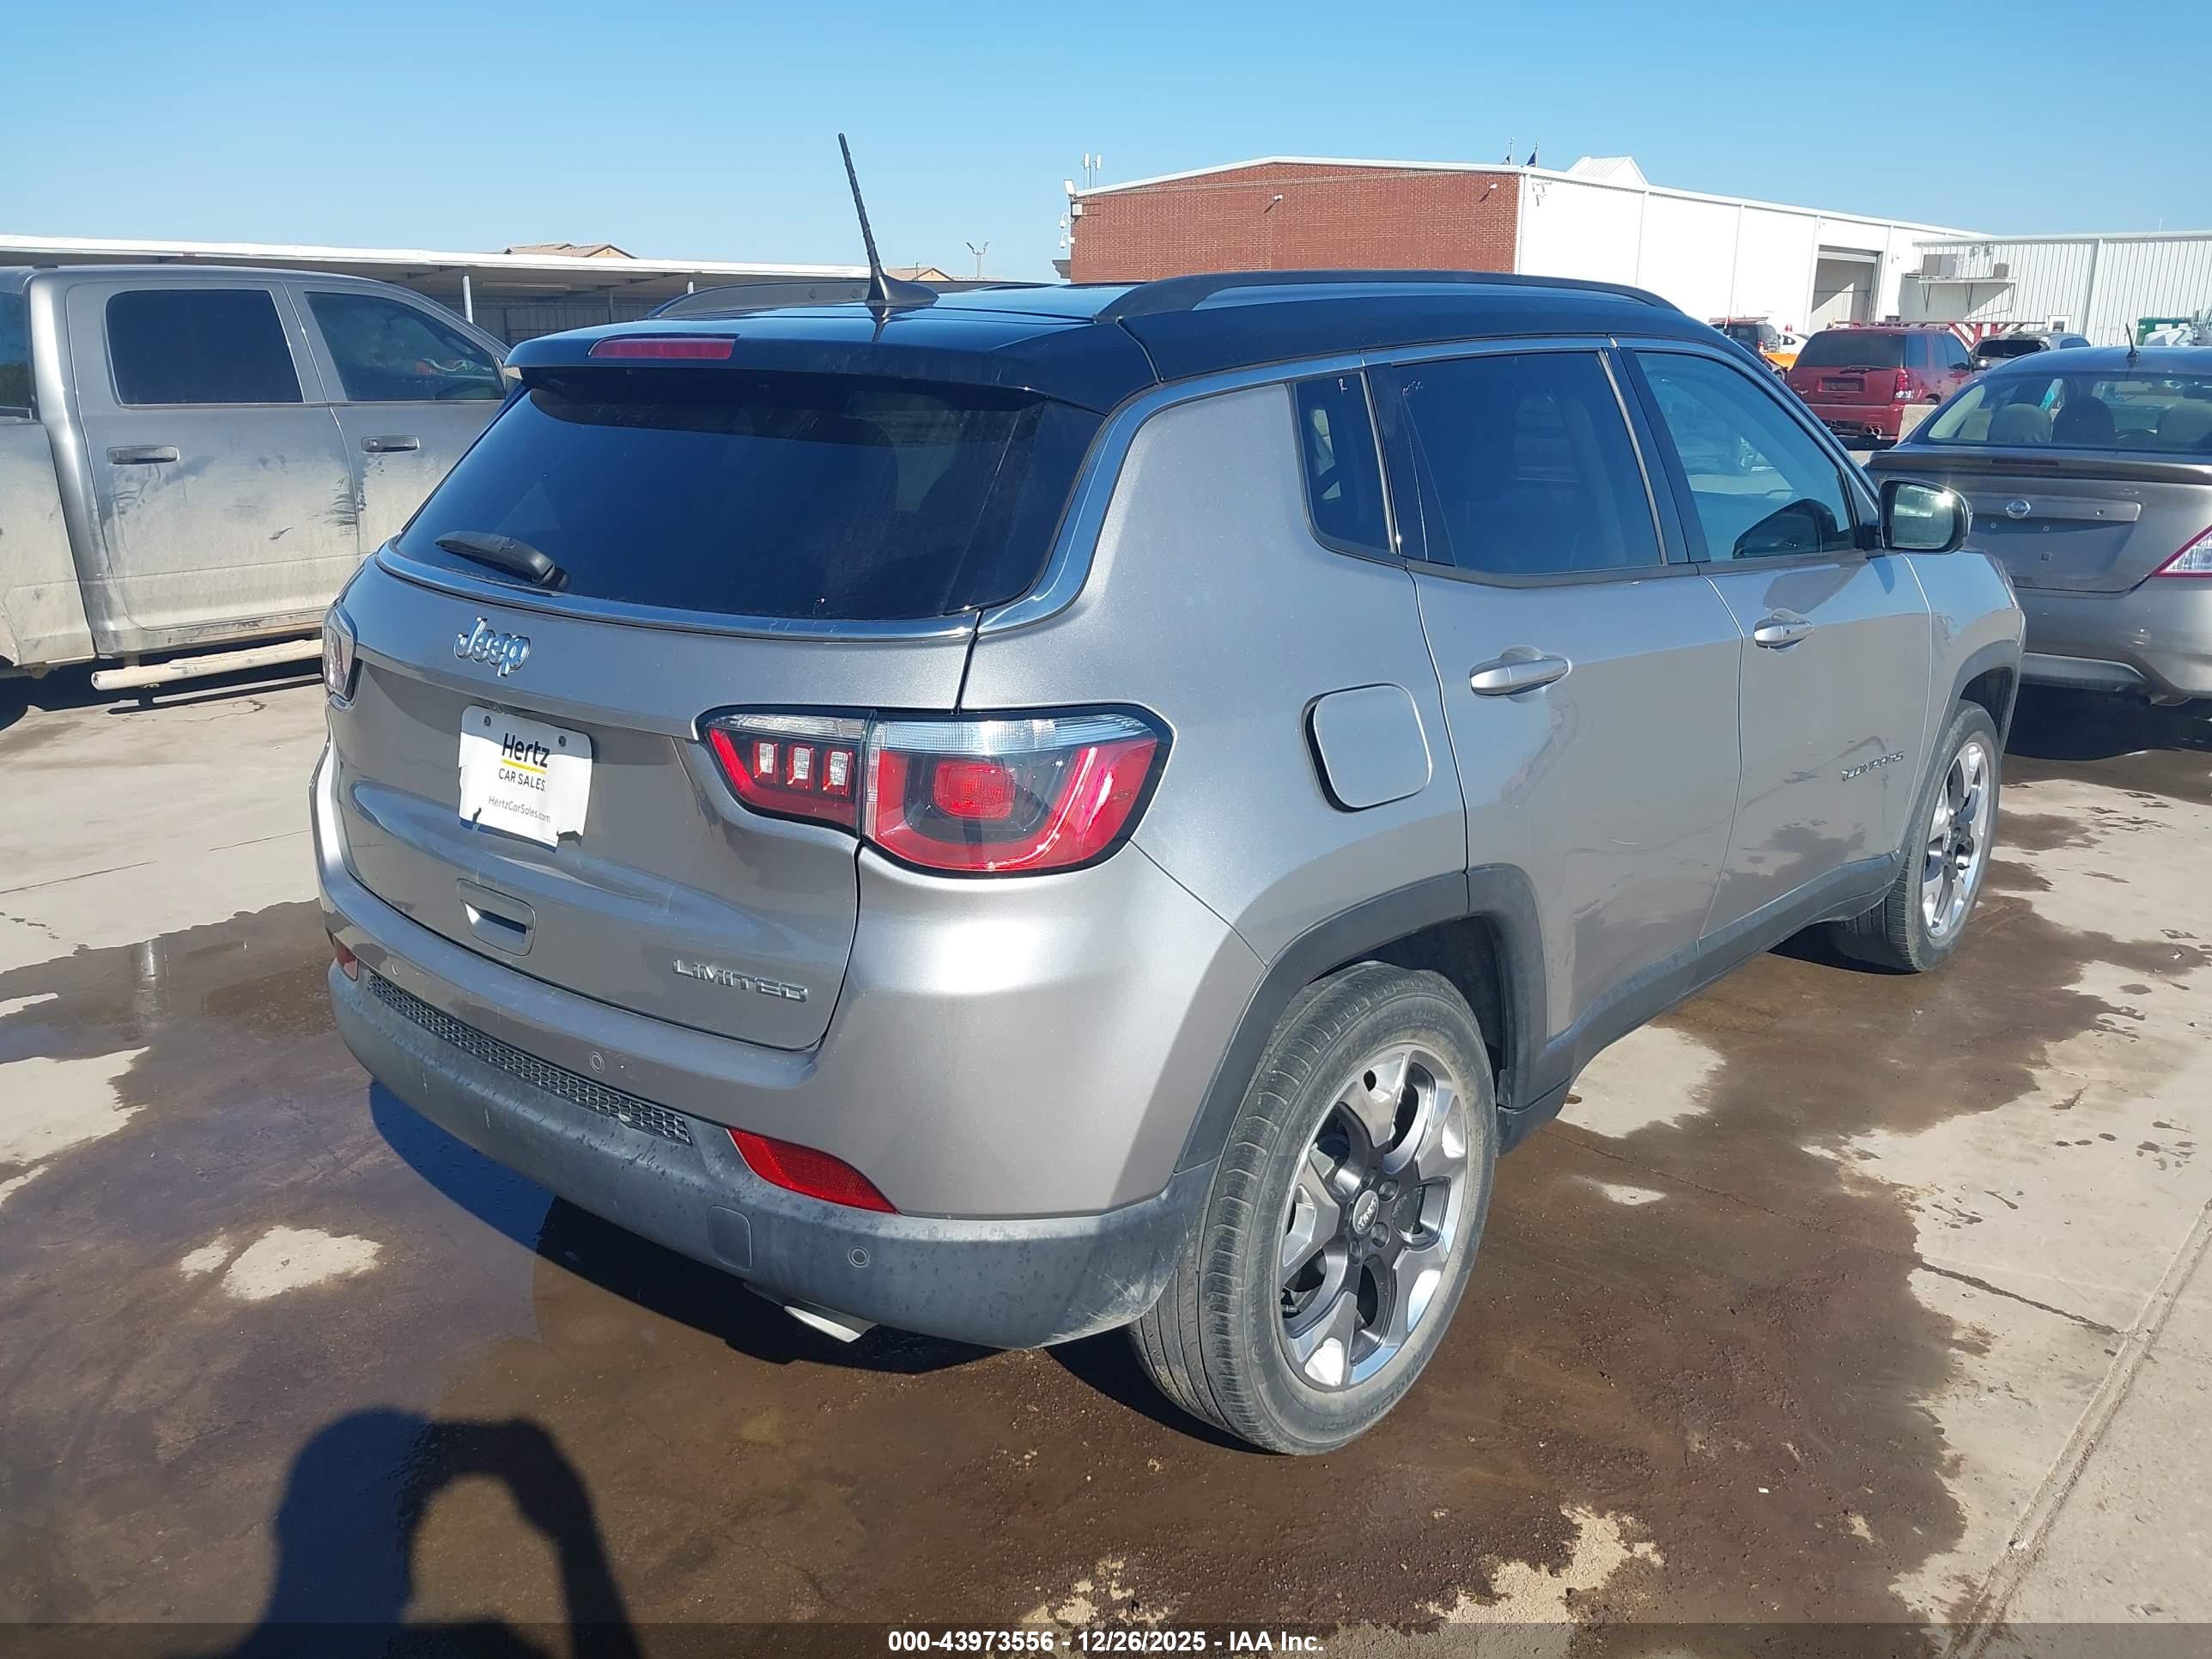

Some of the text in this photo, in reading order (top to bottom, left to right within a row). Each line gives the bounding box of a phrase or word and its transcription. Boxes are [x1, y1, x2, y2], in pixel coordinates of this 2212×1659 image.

[453, 616, 531, 678] Jeep
[501, 732, 550, 768] Hertz
[1840, 750, 1904, 781] COMPASS
[498, 769, 515, 782] CAR
[488, 795, 550, 823] HertzCarSales.com
[672, 959, 809, 1003] LIMITED
